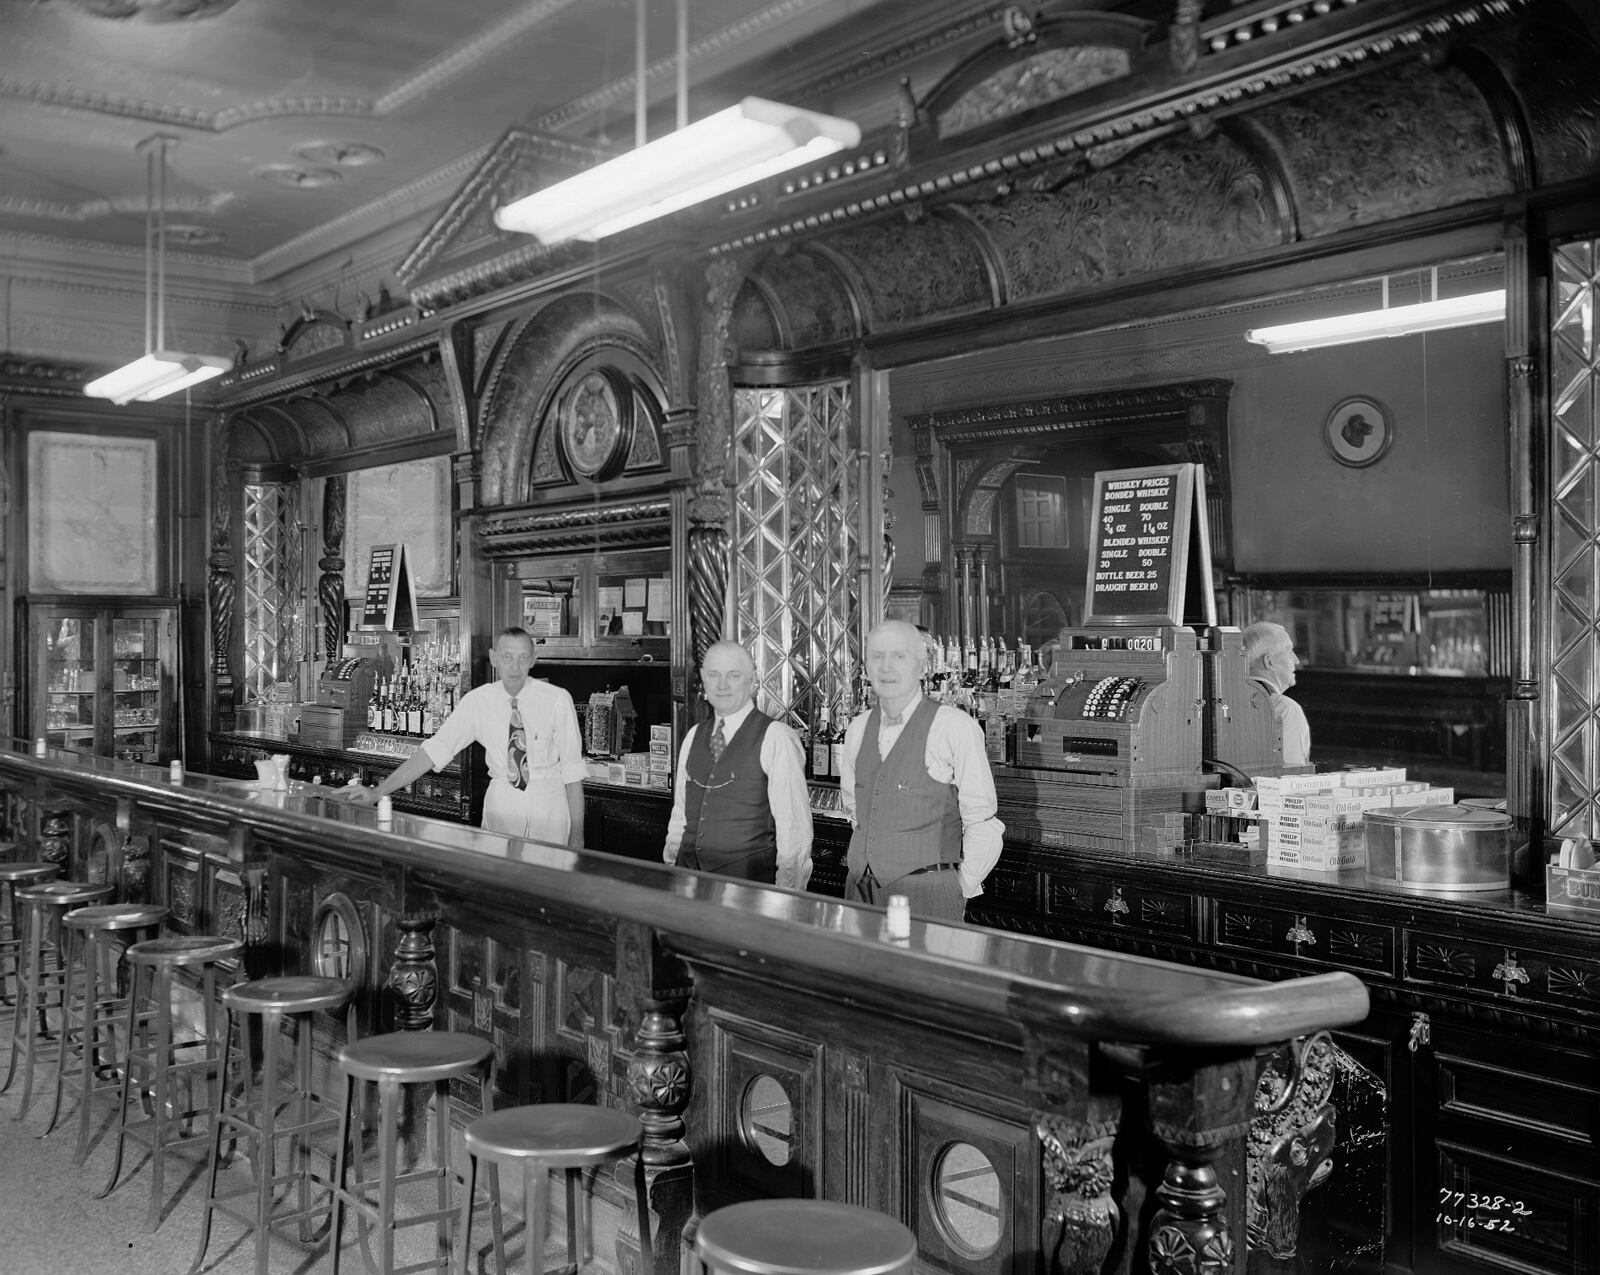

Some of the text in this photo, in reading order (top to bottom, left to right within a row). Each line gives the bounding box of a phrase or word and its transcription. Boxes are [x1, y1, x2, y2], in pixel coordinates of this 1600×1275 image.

[1108, 477, 1169, 491] WHISKEY PRICES
[1104, 488, 1169, 501] BONDED WHISKEY
[1104, 501, 1168, 514] SINGLE DOUBLE
[1102, 513, 1151, 524] 40 70
[1116, 524, 1127, 532] OZ
[1157, 522, 1168, 531] OZ
[1103, 535, 1171, 547] BLENDED WHISKEY
[1101, 548, 1167, 559] SINGLE DOUBLE
[1100, 559, 1152, 568] 30 50
[1096, 570, 1157, 580] BOTTLE BEER 25
[1095, 582, 1158, 592] DRAUGHT BEER 10
[1336, 802, 1361, 813] Old Gold
[1330, 821, 1356, 832] Old Gold
[1279, 838, 1300, 846] MORRIS
[1329, 855, 1356, 866] Old Gold
